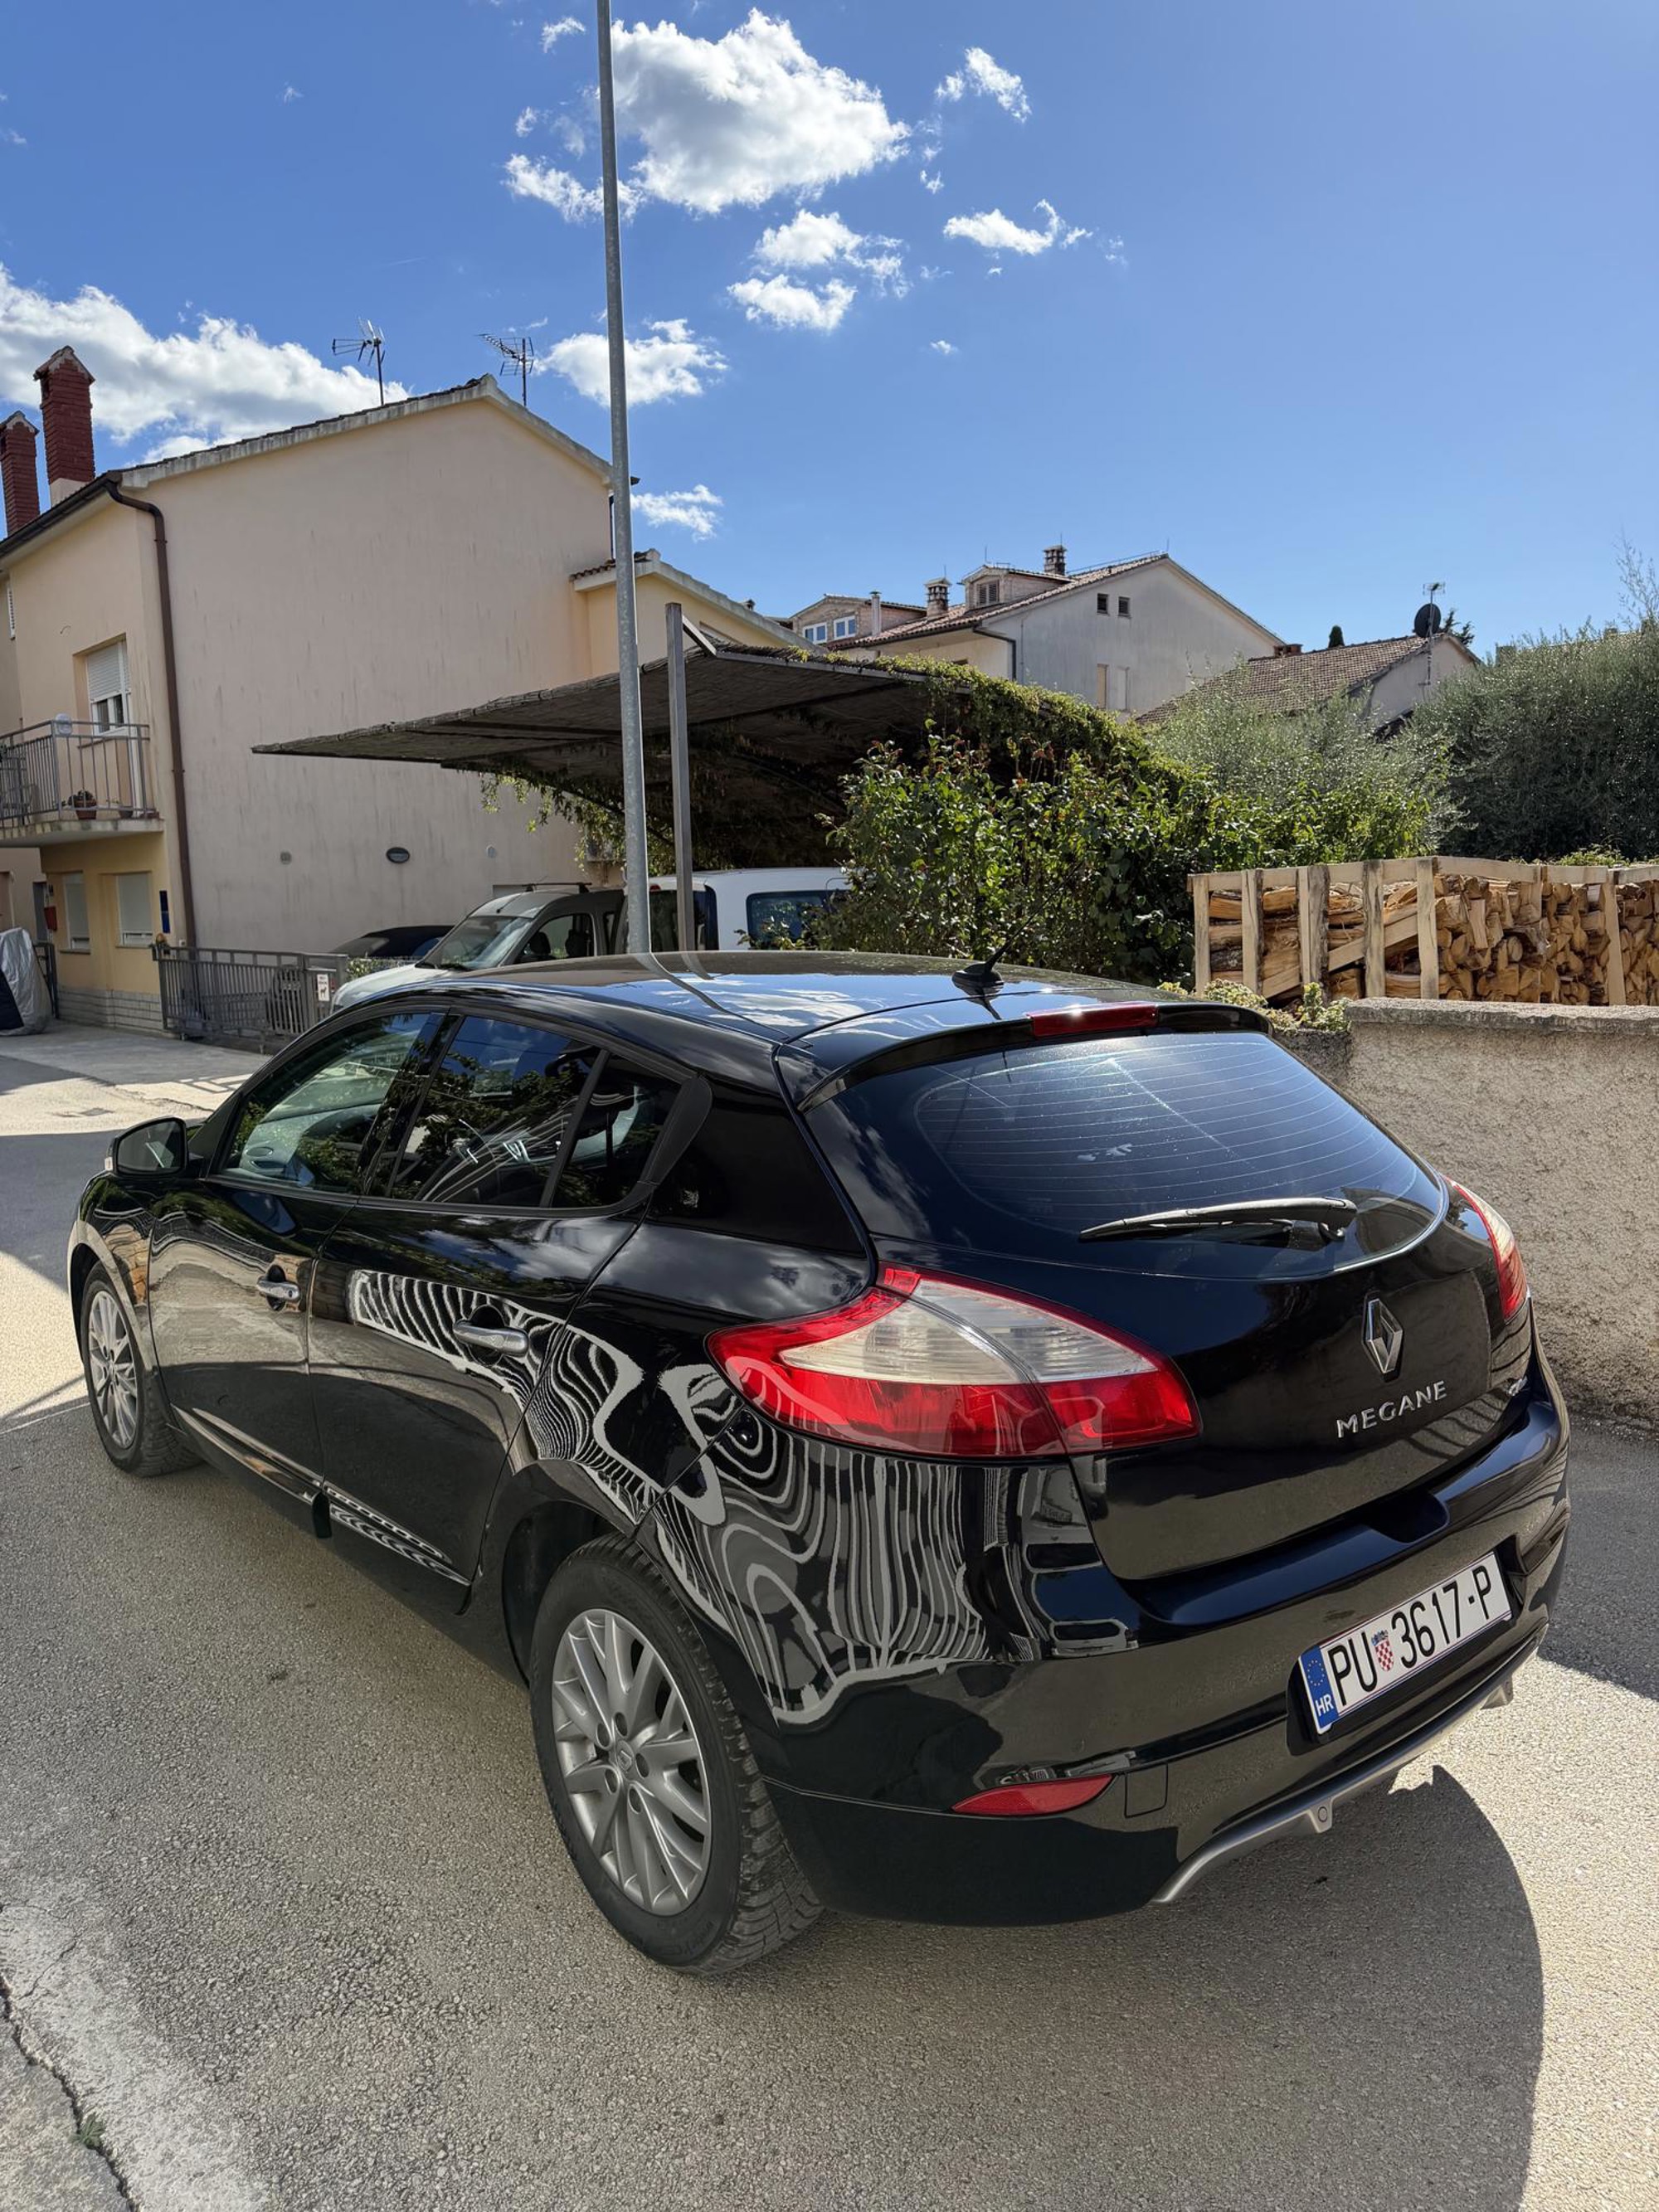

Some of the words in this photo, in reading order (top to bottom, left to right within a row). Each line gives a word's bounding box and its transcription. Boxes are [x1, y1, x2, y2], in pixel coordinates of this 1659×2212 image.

[1336, 1380, 1447, 1438] MEGANE
[1327, 1631, 1378, 1706] PU
[1315, 1694, 1335, 1716] HR
